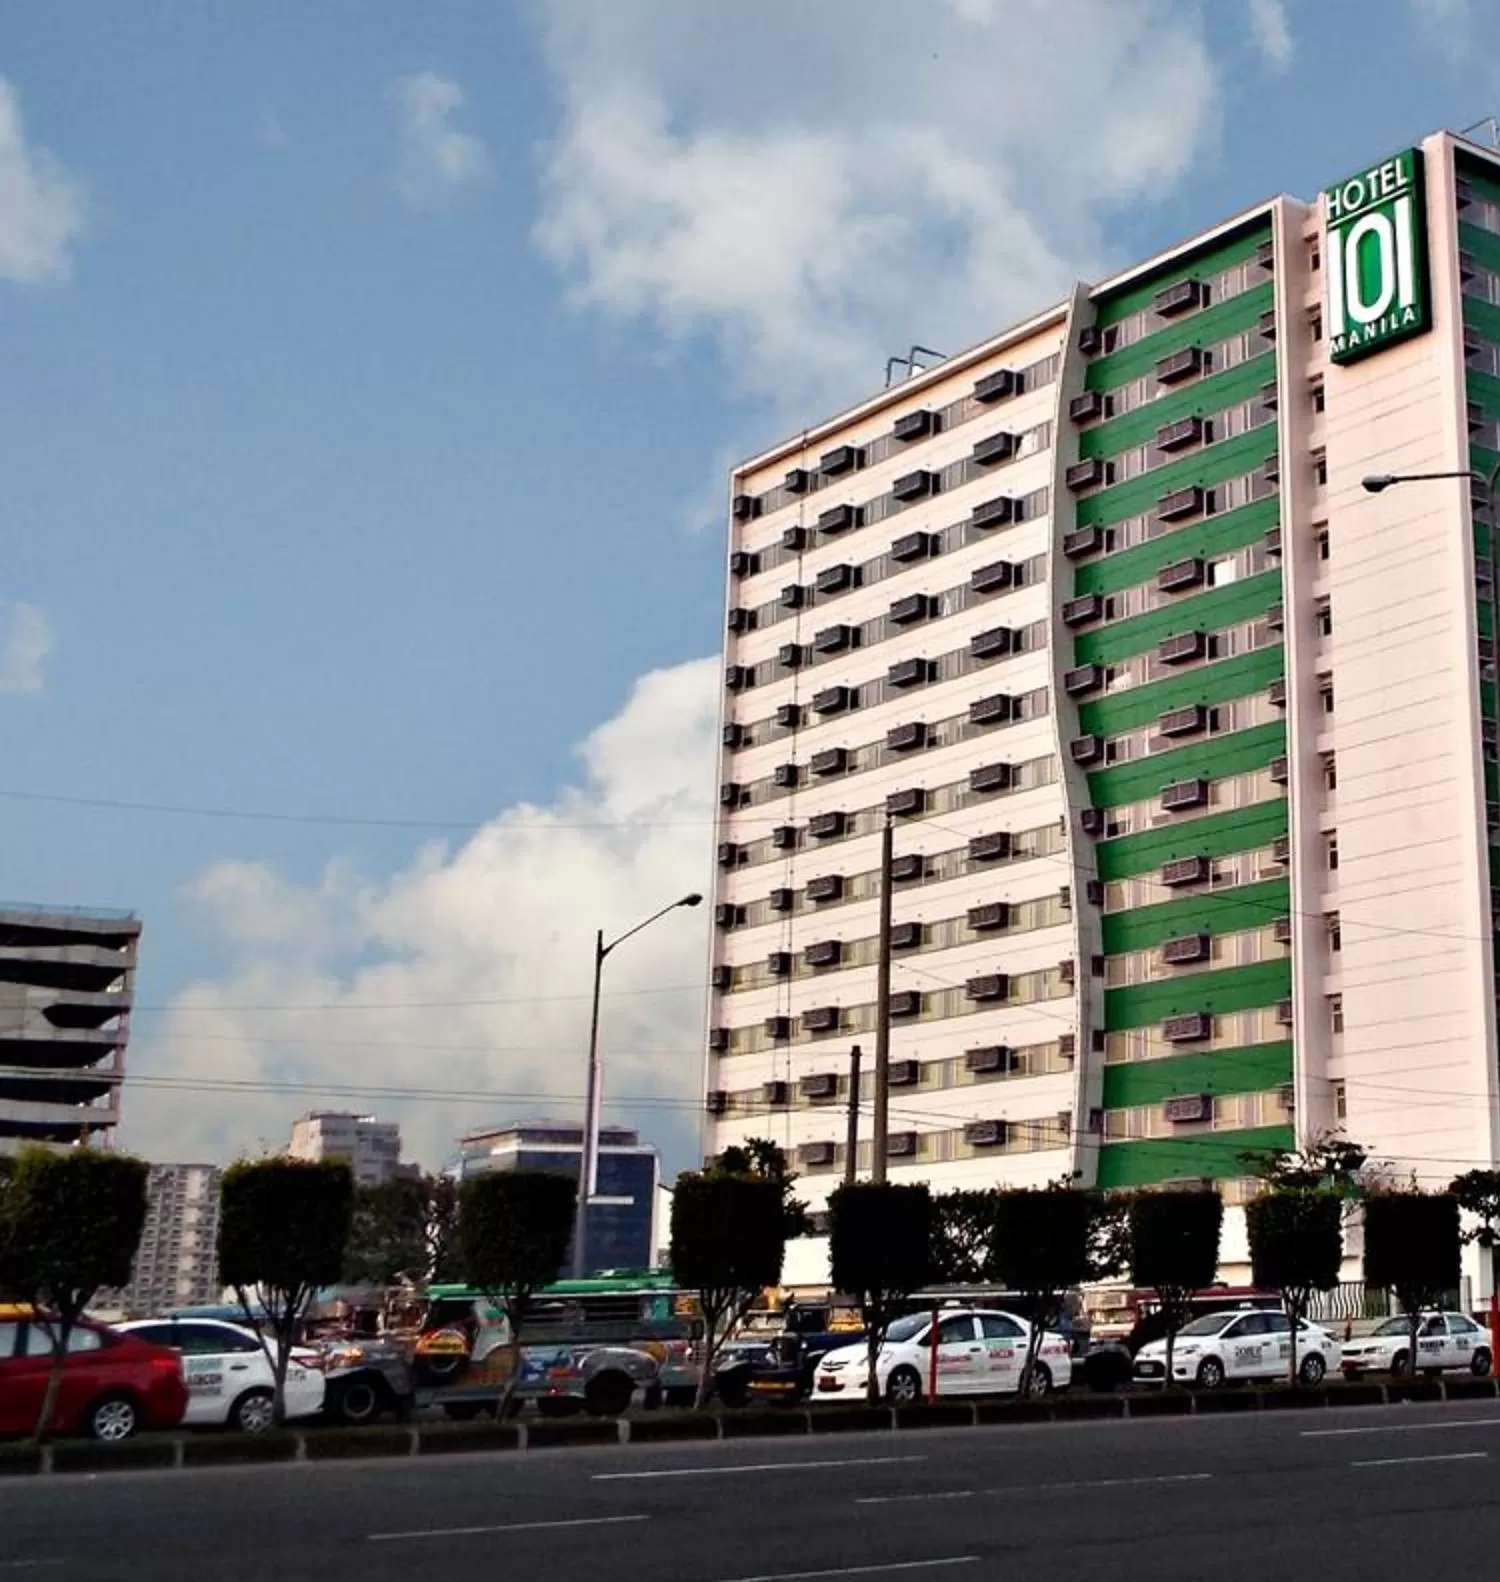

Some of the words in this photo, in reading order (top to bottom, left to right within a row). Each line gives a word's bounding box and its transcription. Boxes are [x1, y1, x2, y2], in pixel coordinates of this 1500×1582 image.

[1327, 158, 1409, 220] HOTEL
[1327, 196, 1416, 341] 101
[1329, 306, 1416, 354] MANILA
